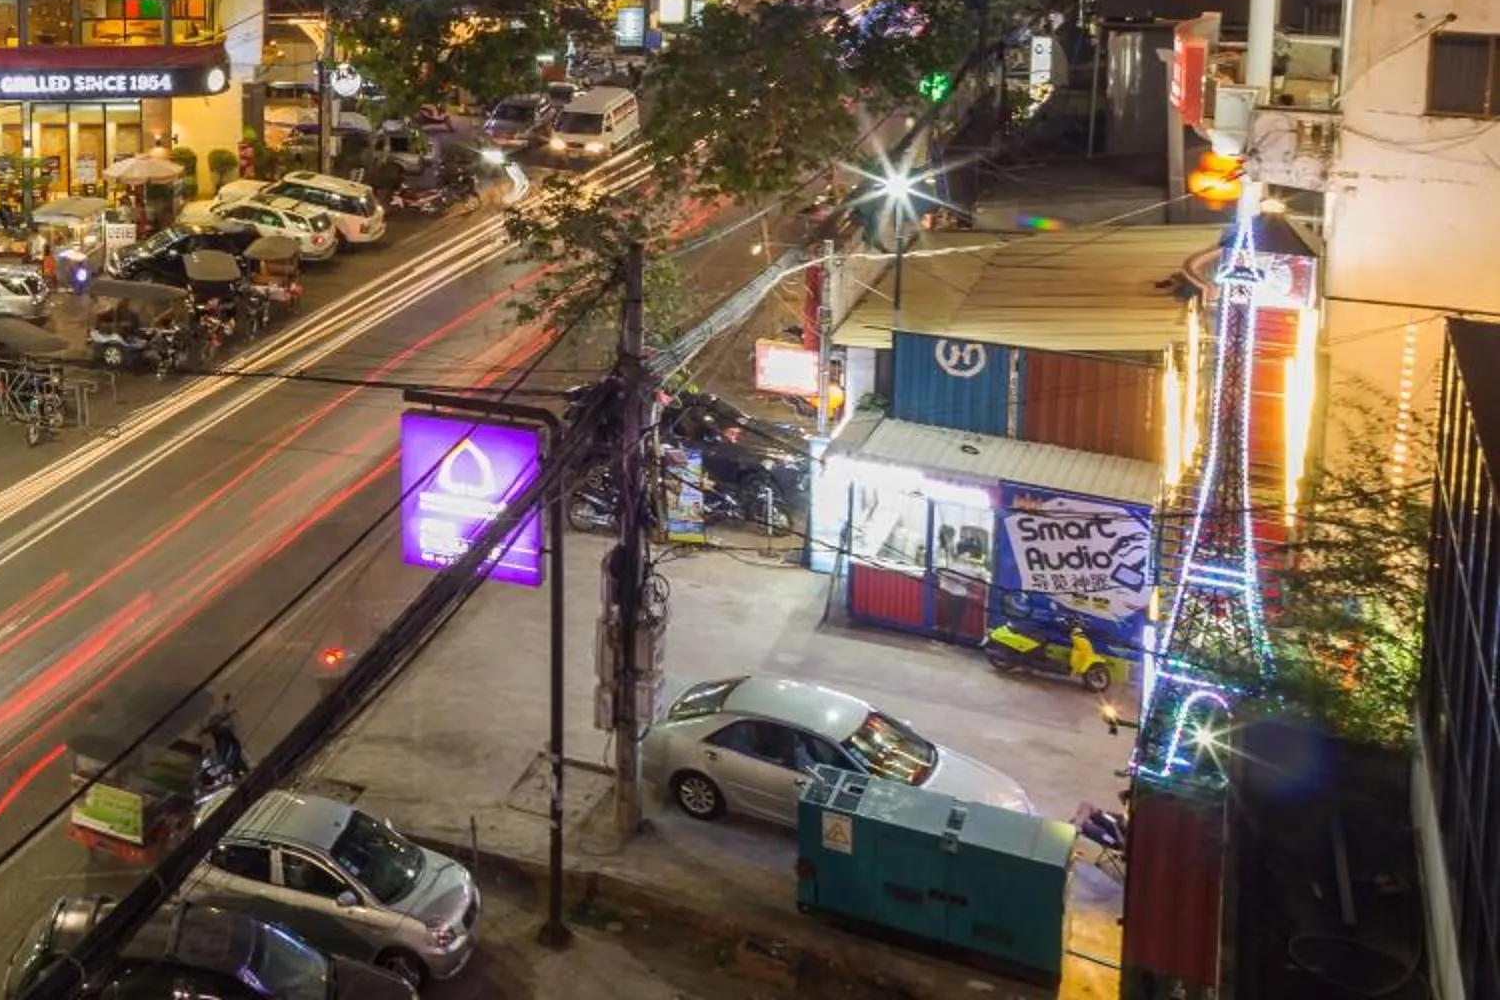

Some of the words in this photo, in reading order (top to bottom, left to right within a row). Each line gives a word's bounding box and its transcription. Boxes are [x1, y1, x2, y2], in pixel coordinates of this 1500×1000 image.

[0, 76, 71, 92] GRILLED
[74, 75, 127, 92] SINCE
[130, 73, 173, 91] 1954
[1017, 516, 1117, 541] Smart
[1025, 545, 1113, 571] Audio
